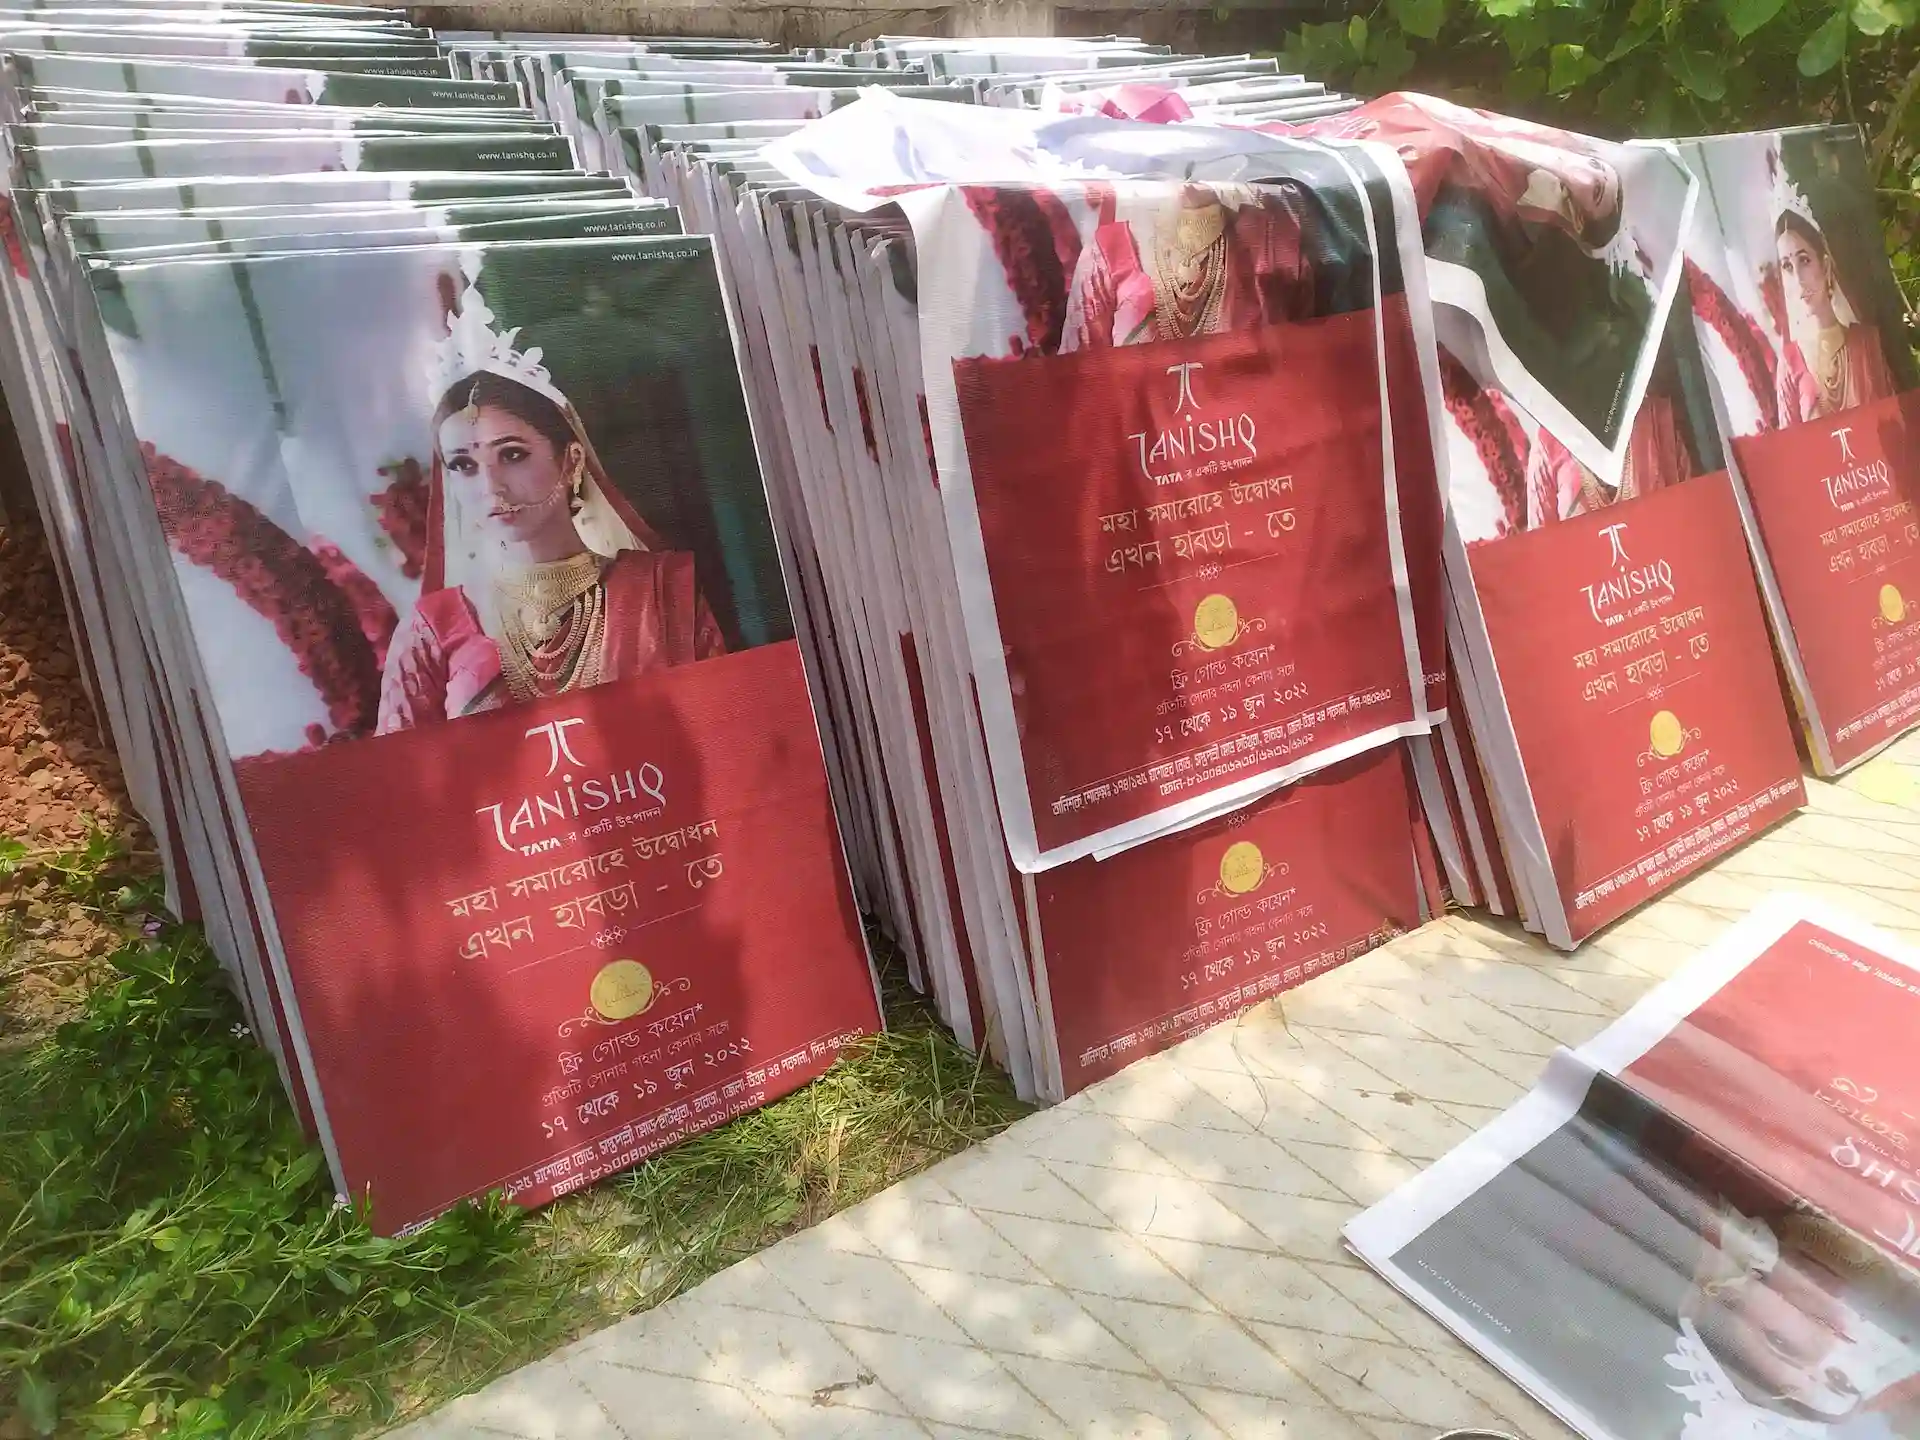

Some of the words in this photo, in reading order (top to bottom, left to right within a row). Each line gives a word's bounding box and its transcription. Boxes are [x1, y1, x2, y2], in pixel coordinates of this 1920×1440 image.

[363, 67, 438, 77] www.tanishq.co.in
[432, 90, 506, 101] www.tanishq.co.in
[477, 150, 557, 163] www.tanishq.co.in
[584, 219, 666, 232] www.tanishq.co.in
[611, 248, 699, 262] www.tanishq.co.in
[1098, 509, 1138, 534] মহা
[1145, 489, 1224, 525] সমারোহে
[1229, 474, 1293, 506] উদ্বোধন
[1104, 540, 1162, 573] এখন
[1170, 520, 1233, 561] হাবড়া
[1266, 508, 1296, 538] তে
[1573, 648, 1599, 670] মহা
[1600, 624, 1660, 659] সমারোহে
[1660, 605, 1705, 635] উদ্বোধন
[1170, 669, 1188, 691] ফ্রি
[1194, 659, 1227, 684] গোল্ড
[1582, 671, 1619, 701] এখন
[1624, 649, 1669, 682] হাবড়া
[1688, 632, 1710, 660] তে
[1155, 726, 1174, 744] ১৭
[1179, 711, 1211, 737] থেকে
[1220, 705, 1237, 722] ১৯
[1242, 693, 1266, 720] জুন
[1273, 681, 1309, 705] ২০২২
[582, 816, 613, 839] একটি
[615, 806, 661, 829] উৎপাদন
[446, 886, 499, 920] মহা
[506, 847, 629, 900] সমারোহে
[631, 818, 720, 859] উদ্বোধন
[459, 915, 535, 960] এখন
[550, 880, 639, 931] হাবড়া
[684, 853, 724, 890] তে
[1218, 905, 1252, 929] গোল্ড
[1180, 971, 1199, 990] ১৭
[1204, 955, 1234, 982] থেকে
[1243, 947, 1261, 965] ১৯
[1265, 935, 1286, 961] জুন
[1293, 922, 1328, 945] ২০২২
[542, 1078, 583, 1109] প্রতিটি
[587, 1061, 628, 1088] সোনার
[632, 1046, 662, 1069] গহনা
[667, 1032, 702, 1056] কেনার
[558, 1050, 583, 1076] ফ্রি
[592, 1029, 641, 1063] গোল্ড
[768, 1065, 781, 1079] ২৪
[541, 1114, 569, 1139] ১৭
[576, 1089, 620, 1125] থেকে
[634, 1078, 658, 1100] ১৯
[664, 1058, 695, 1090] জুন
[704, 1036, 754, 1068] ২০২২
[1829, 1076, 1878, 1104] তে
